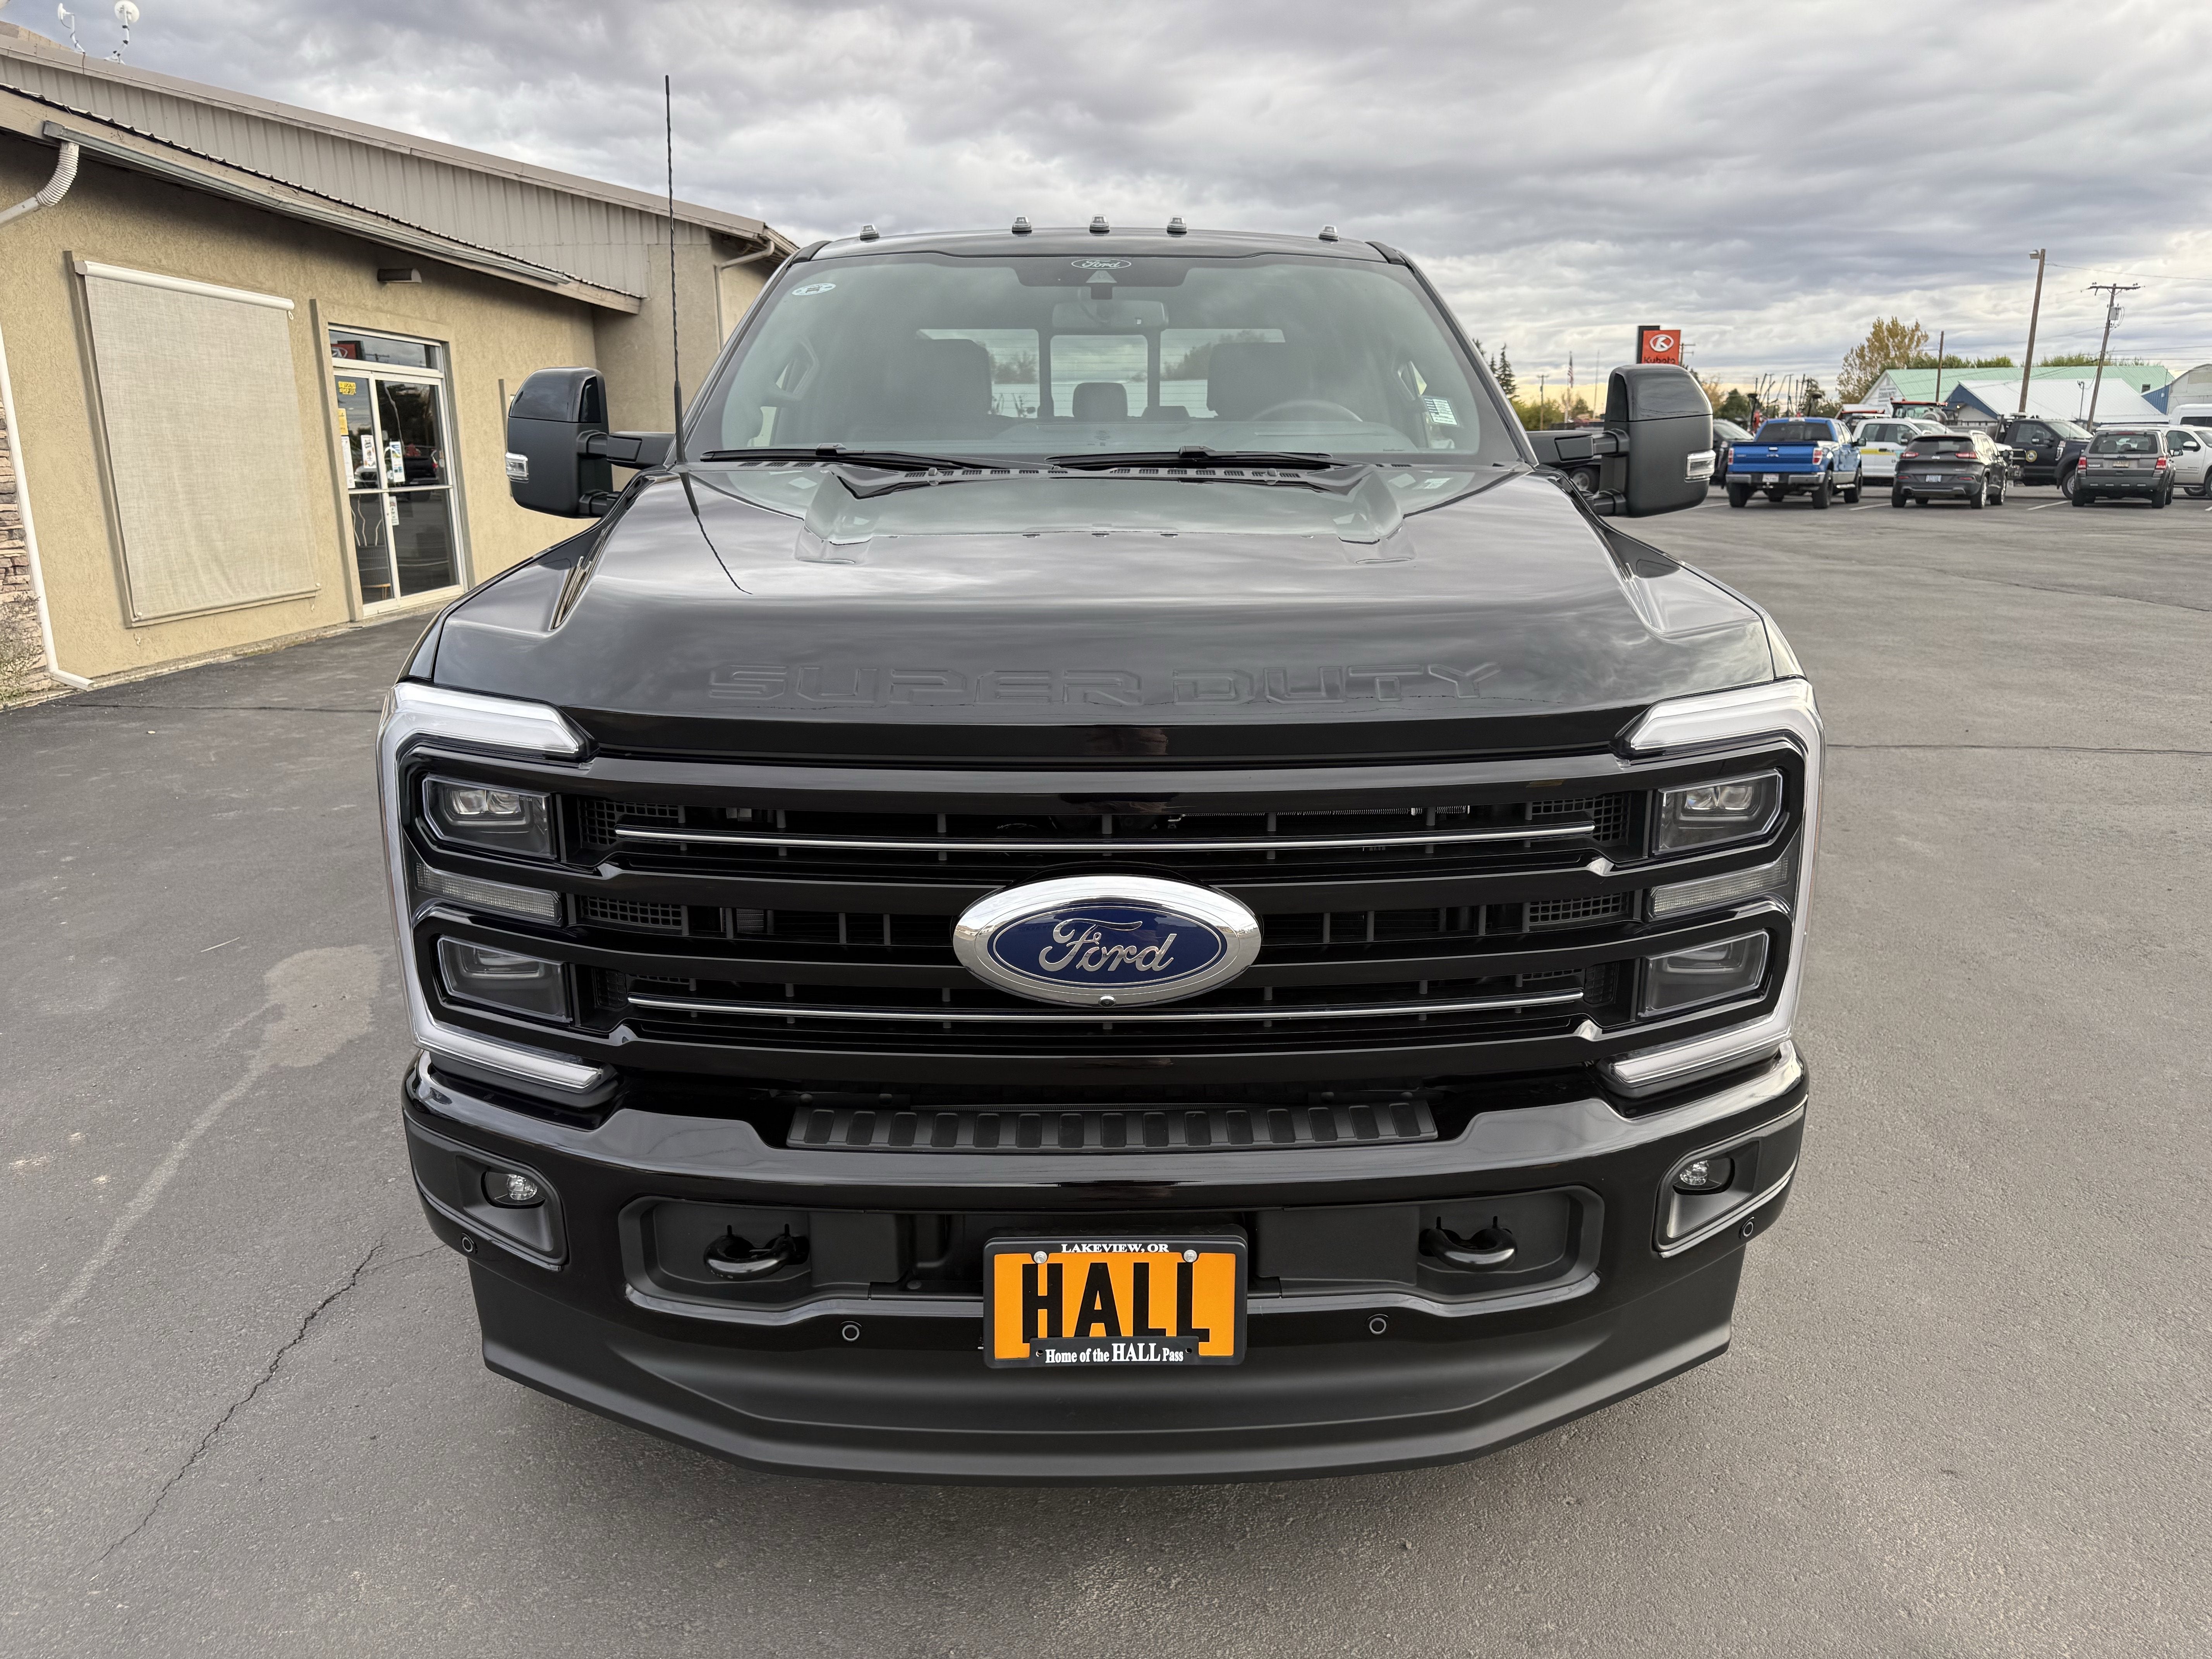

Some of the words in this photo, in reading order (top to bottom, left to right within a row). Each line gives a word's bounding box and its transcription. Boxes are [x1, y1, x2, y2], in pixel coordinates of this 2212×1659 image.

[1082, 259, 1121, 268] Ford
[709, 665, 1145, 706] SUPER
[1172, 661, 1502, 706] DUTY
[1038, 918, 1177, 972] Ford
[1061, 1243, 1145, 1253] LAKEVIEW,
[1147, 1243, 1170, 1253] OR
[1022, 1262, 1210, 1343] HALL
[1045, 1349, 1077, 1363] Home
[1079, 1348, 1092, 1362] of
[1092, 1348, 1110, 1362] the
[1111, 1343, 1161, 1362] HALL
[1162, 1348, 1184, 1362] Pass
